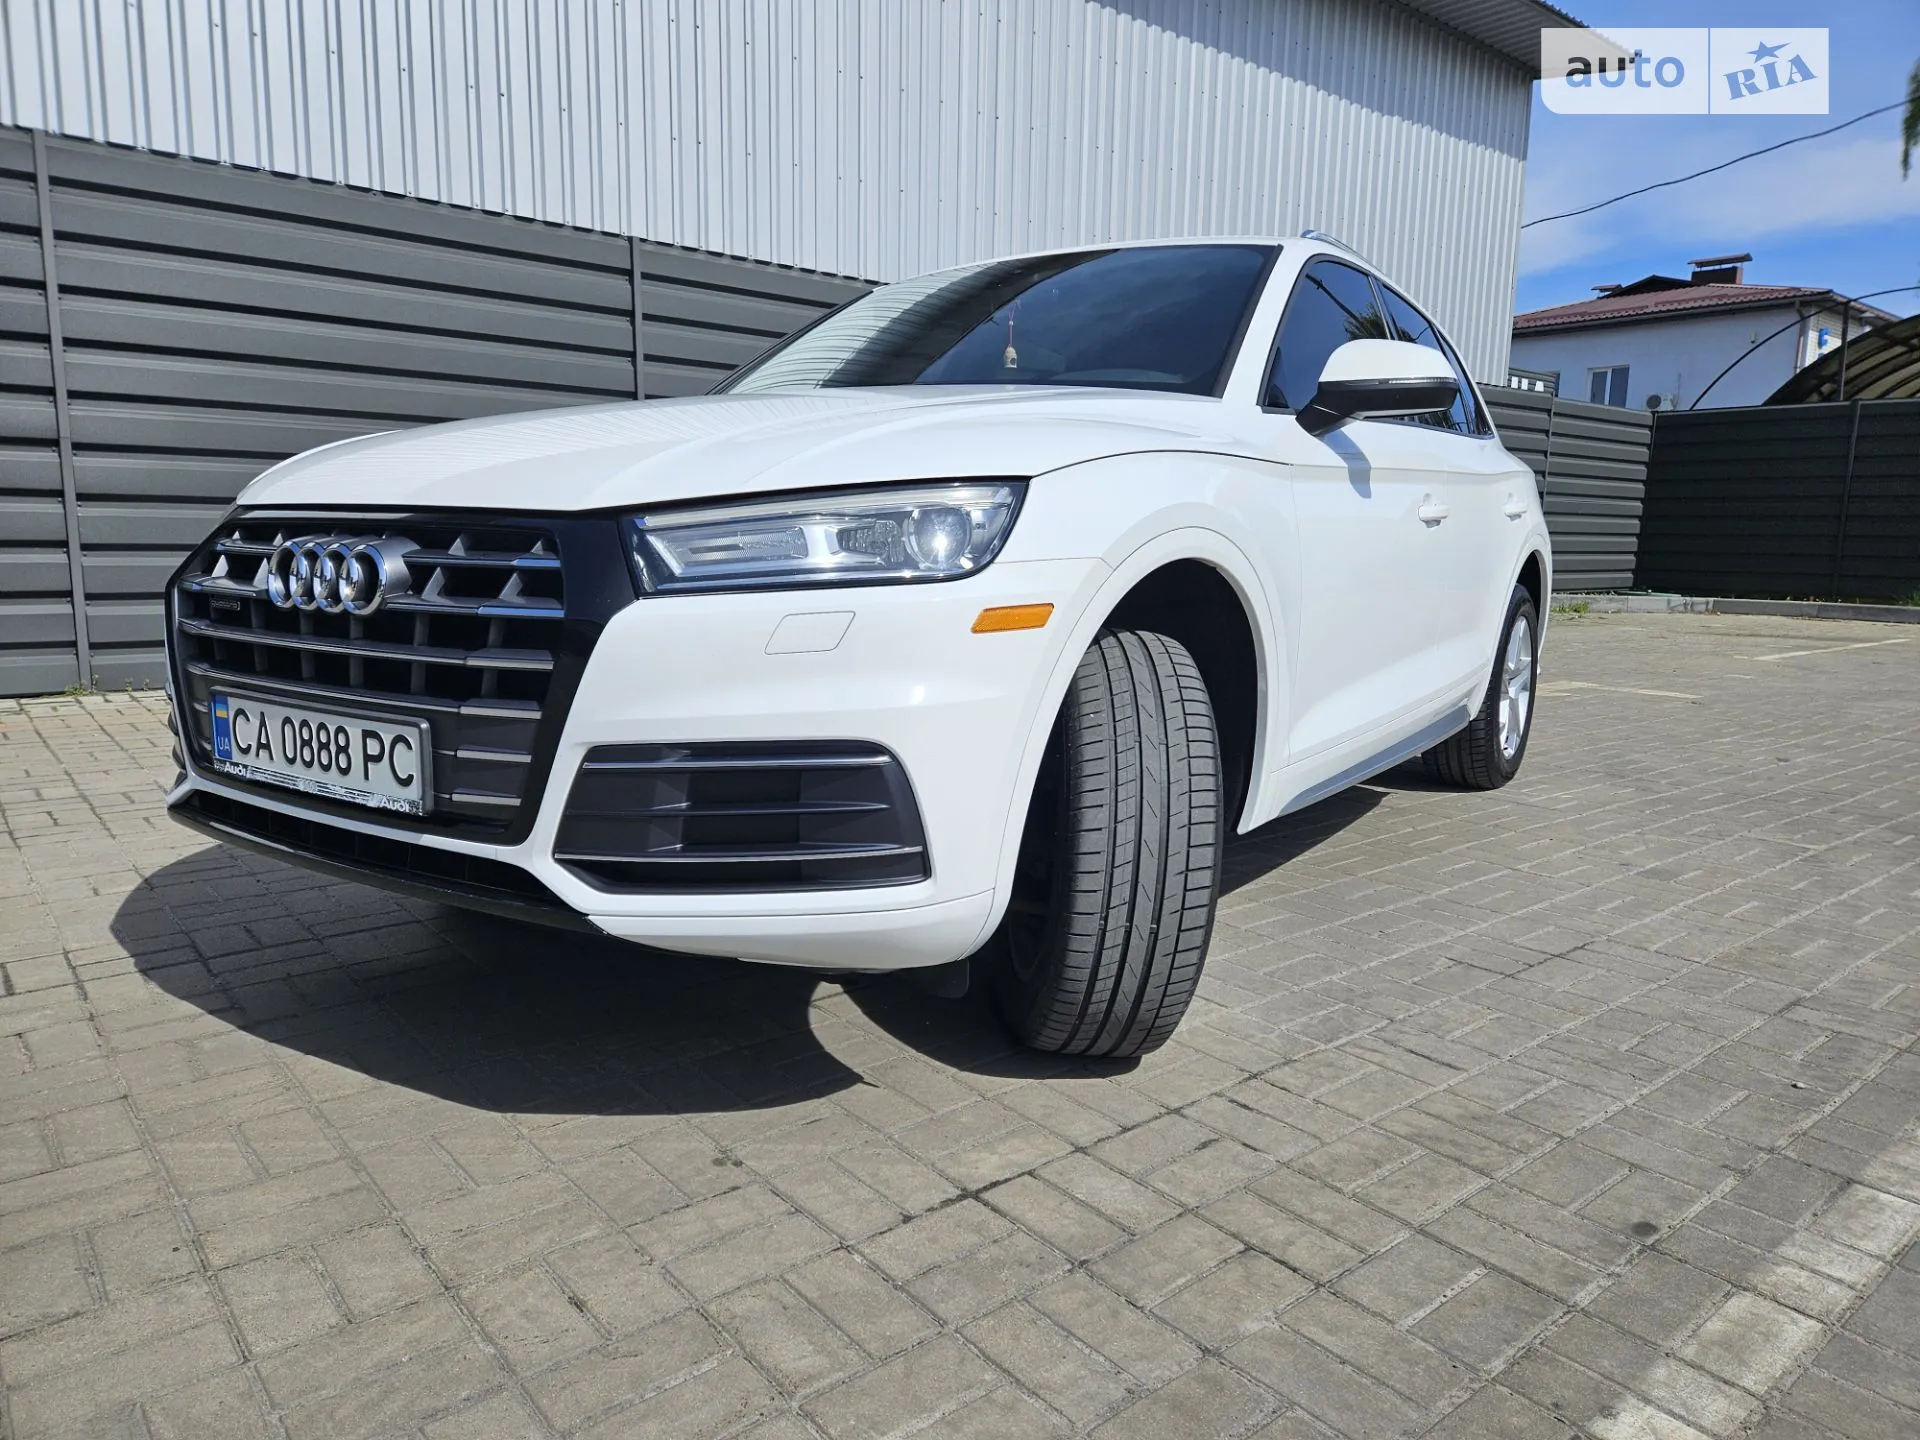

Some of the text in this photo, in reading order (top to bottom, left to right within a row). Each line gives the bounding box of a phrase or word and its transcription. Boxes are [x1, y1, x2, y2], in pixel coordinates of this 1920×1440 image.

[217, 737, 232, 751] UA
[232, 707, 415, 788] CA 0888 PC
[225, 763, 247, 777] Audi
[381, 796, 410, 813] Audi
